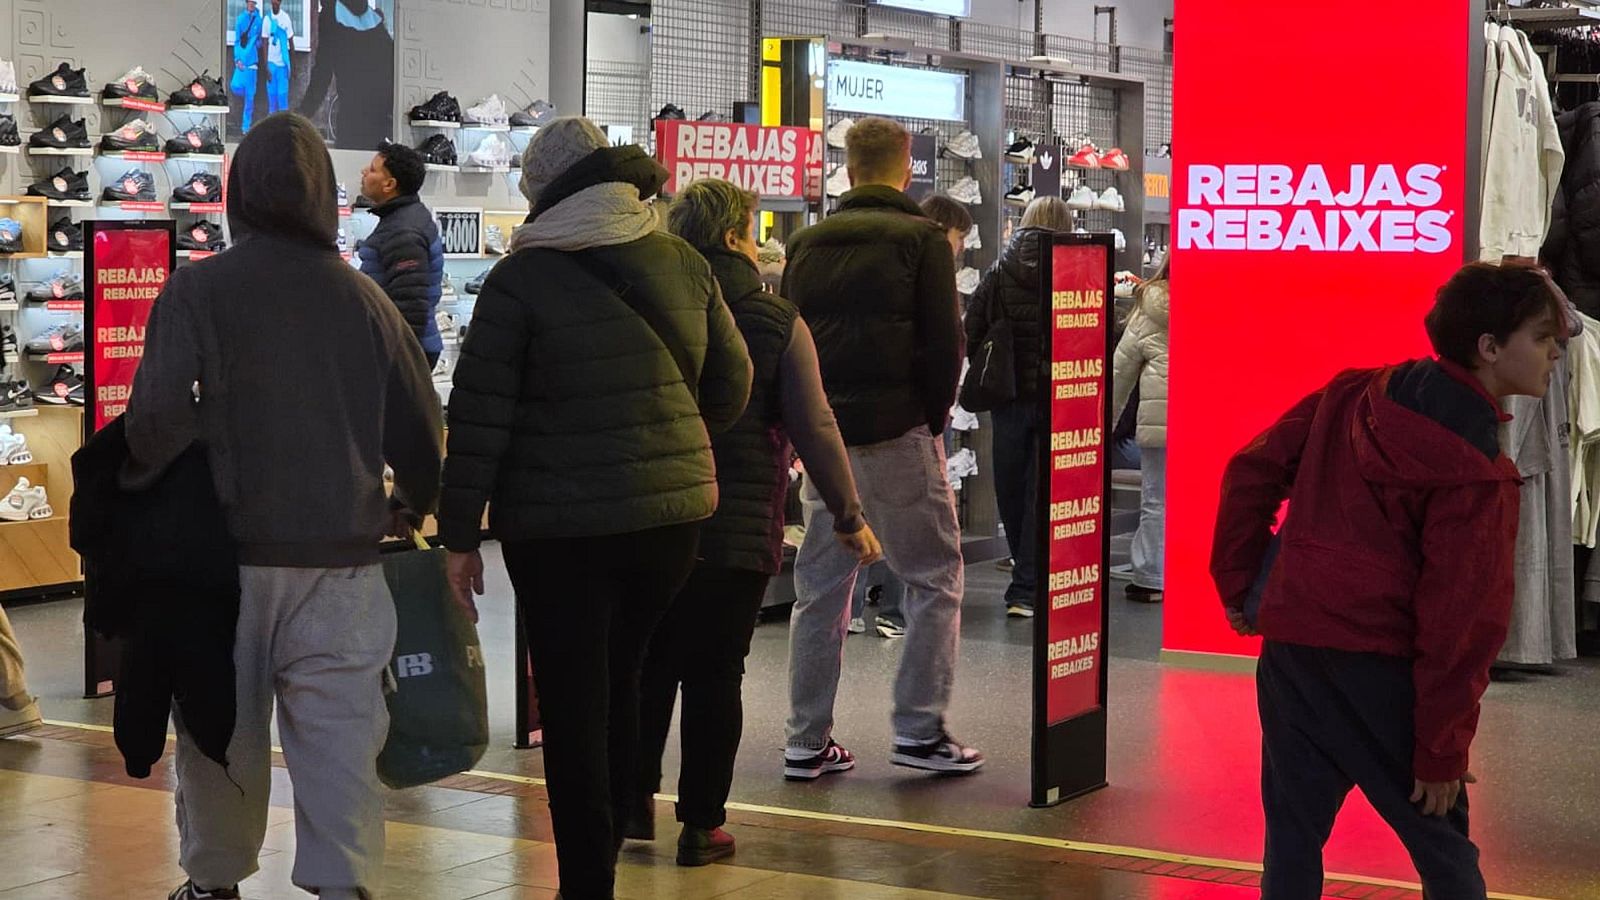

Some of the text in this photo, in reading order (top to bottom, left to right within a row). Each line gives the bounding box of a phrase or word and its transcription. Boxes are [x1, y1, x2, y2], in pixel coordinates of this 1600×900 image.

[836, 75, 884, 100] MUJER
[676, 124, 797, 163] REBAJAS
[97, 267, 165, 284] REBAJAS
[103, 287, 159, 300] REBAIXES
[1051, 290, 1103, 310] REBAJAS
[1056, 313, 1099, 329] REBAIXES
[1051, 359, 1103, 381] REBAJAS
[1055, 382, 1098, 400] REBAIXES
[1050, 428, 1101, 451] REBAJAS
[1054, 451, 1097, 470] REBAIXES
[1049, 496, 1100, 522] REBAJAS
[1053, 519, 1096, 541] REBAIXES
[1048, 564, 1099, 592] REBAJAS
[1052, 588, 1095, 610] REBAIXES
[1047, 632, 1099, 662] REBAJAS
[1051, 656, 1094, 680] REBAIXES
